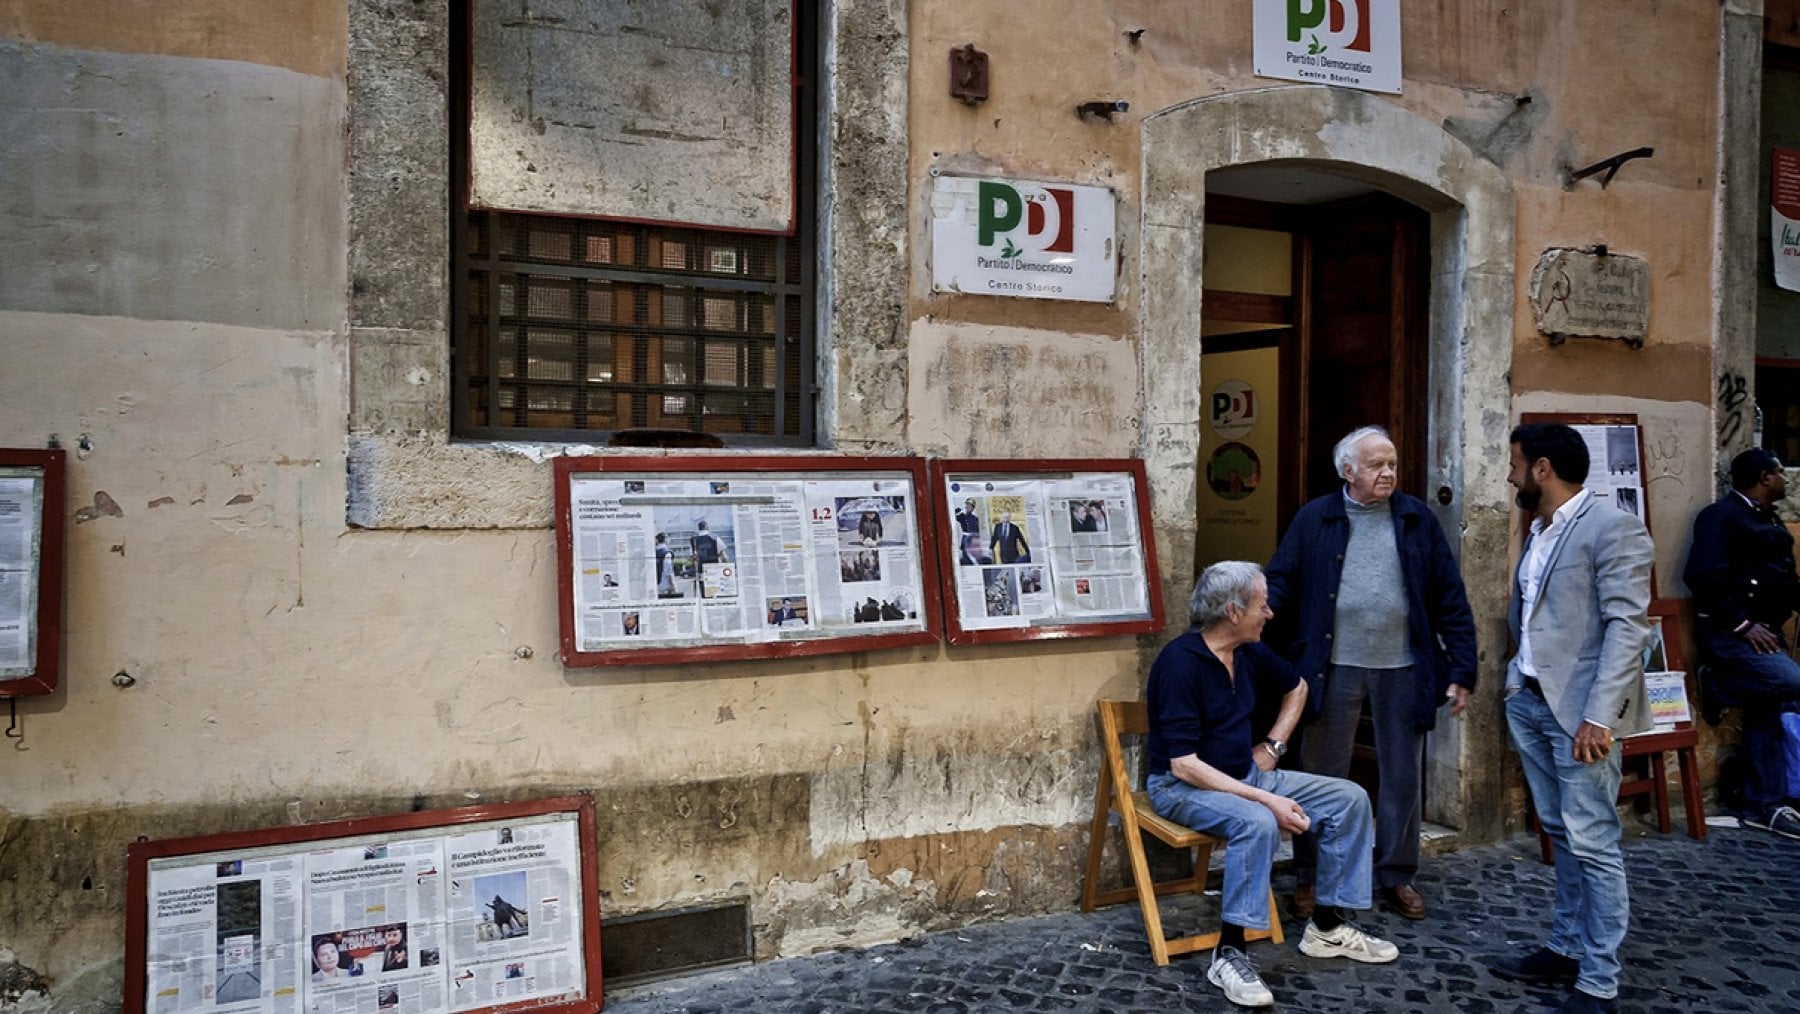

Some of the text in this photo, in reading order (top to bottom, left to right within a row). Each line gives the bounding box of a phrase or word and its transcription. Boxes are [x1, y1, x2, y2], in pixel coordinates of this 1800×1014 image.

[1286, 52, 1372, 74] Partito Democratico
[1298, 69, 1360, 84] Centro Storico
[978, 181, 1074, 253] PD
[977, 256, 1073, 275] Partito Democratico
[988, 279, 1063, 294] Centro Storico
[1213, 390, 1253, 420] PD
